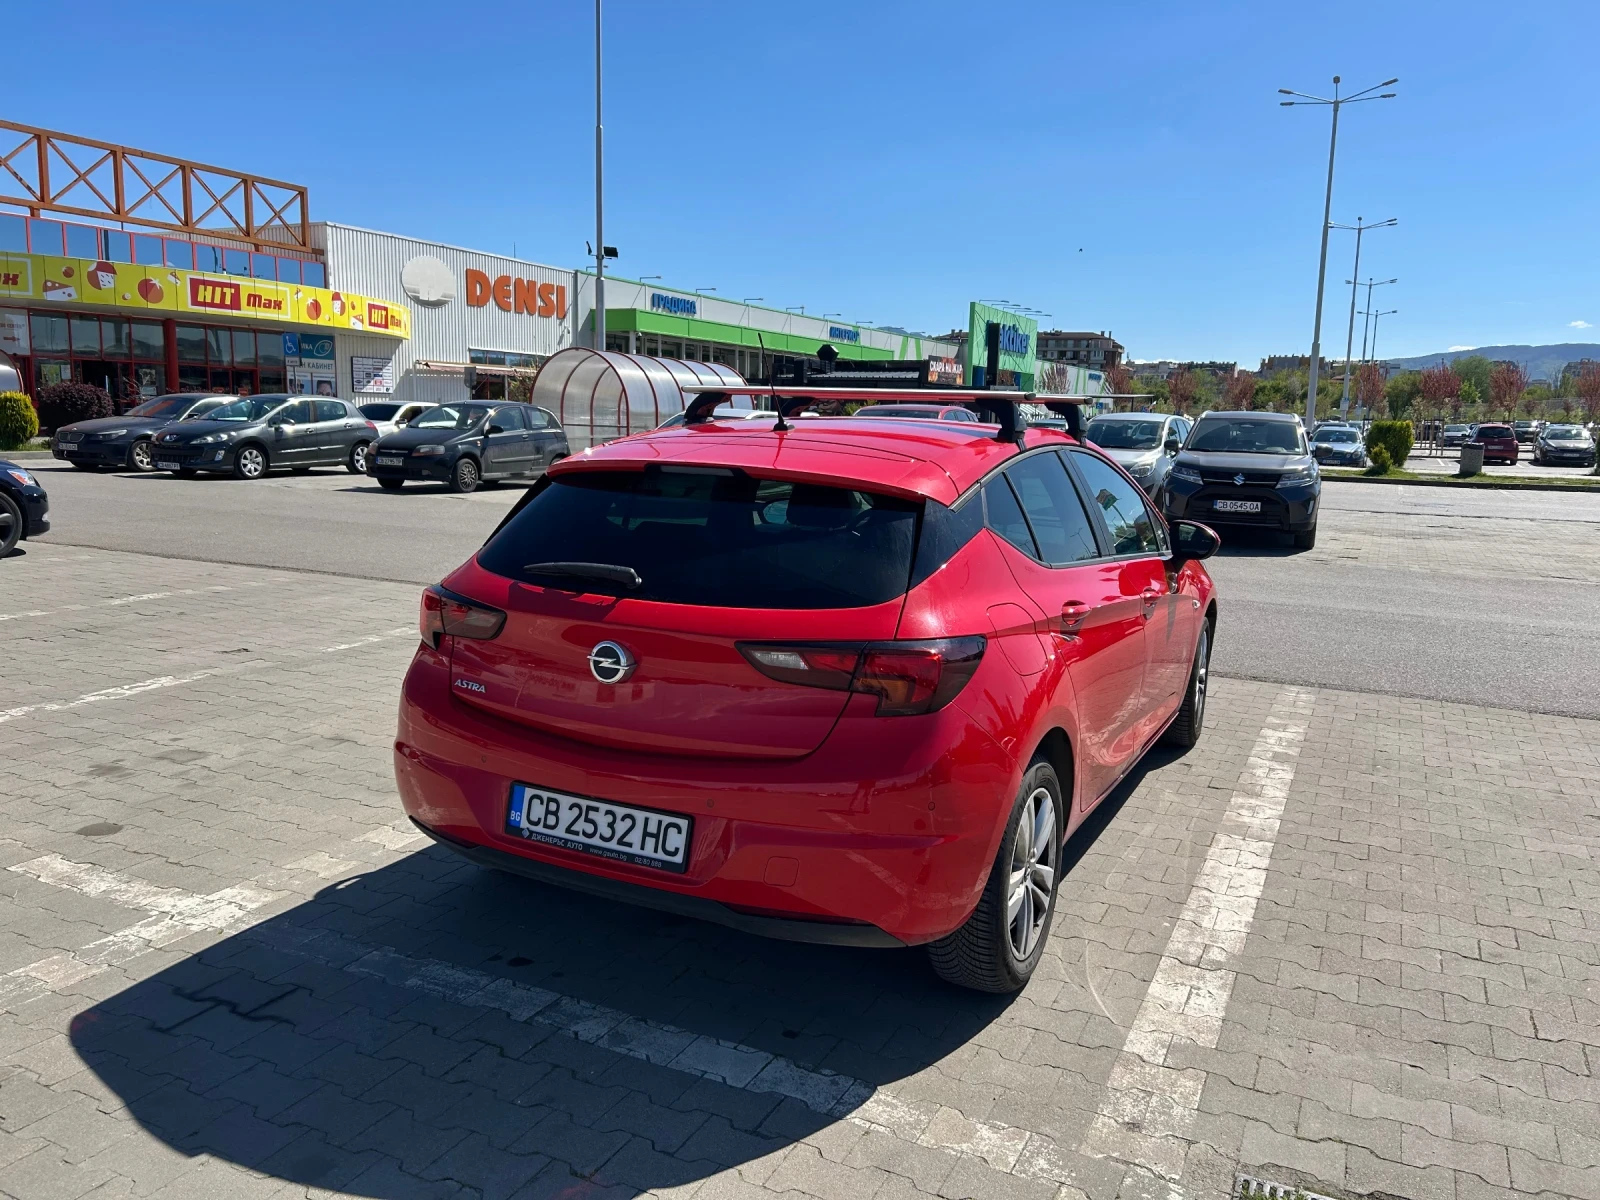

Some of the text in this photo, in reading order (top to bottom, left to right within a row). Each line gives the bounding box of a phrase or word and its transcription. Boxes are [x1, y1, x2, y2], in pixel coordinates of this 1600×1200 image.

[197, 284, 235, 305] HIT
[465, 268, 566, 319] DENSI
[652, 293, 697, 315] ГРАДИНА
[371, 308, 387, 325] HIT
[997, 323, 1030, 355] aktiker
[307, 361, 334, 370] КАБИНЕТ
[1229, 501, 1249, 510] 0545
[454, 679, 486, 694] ASTRA
[510, 811, 521, 821] BG
[565, 803, 637, 848] 2532
[531, 833, 565, 847] ДЖЕНЕРЪС
[566, 841, 583, 851] АУТО
